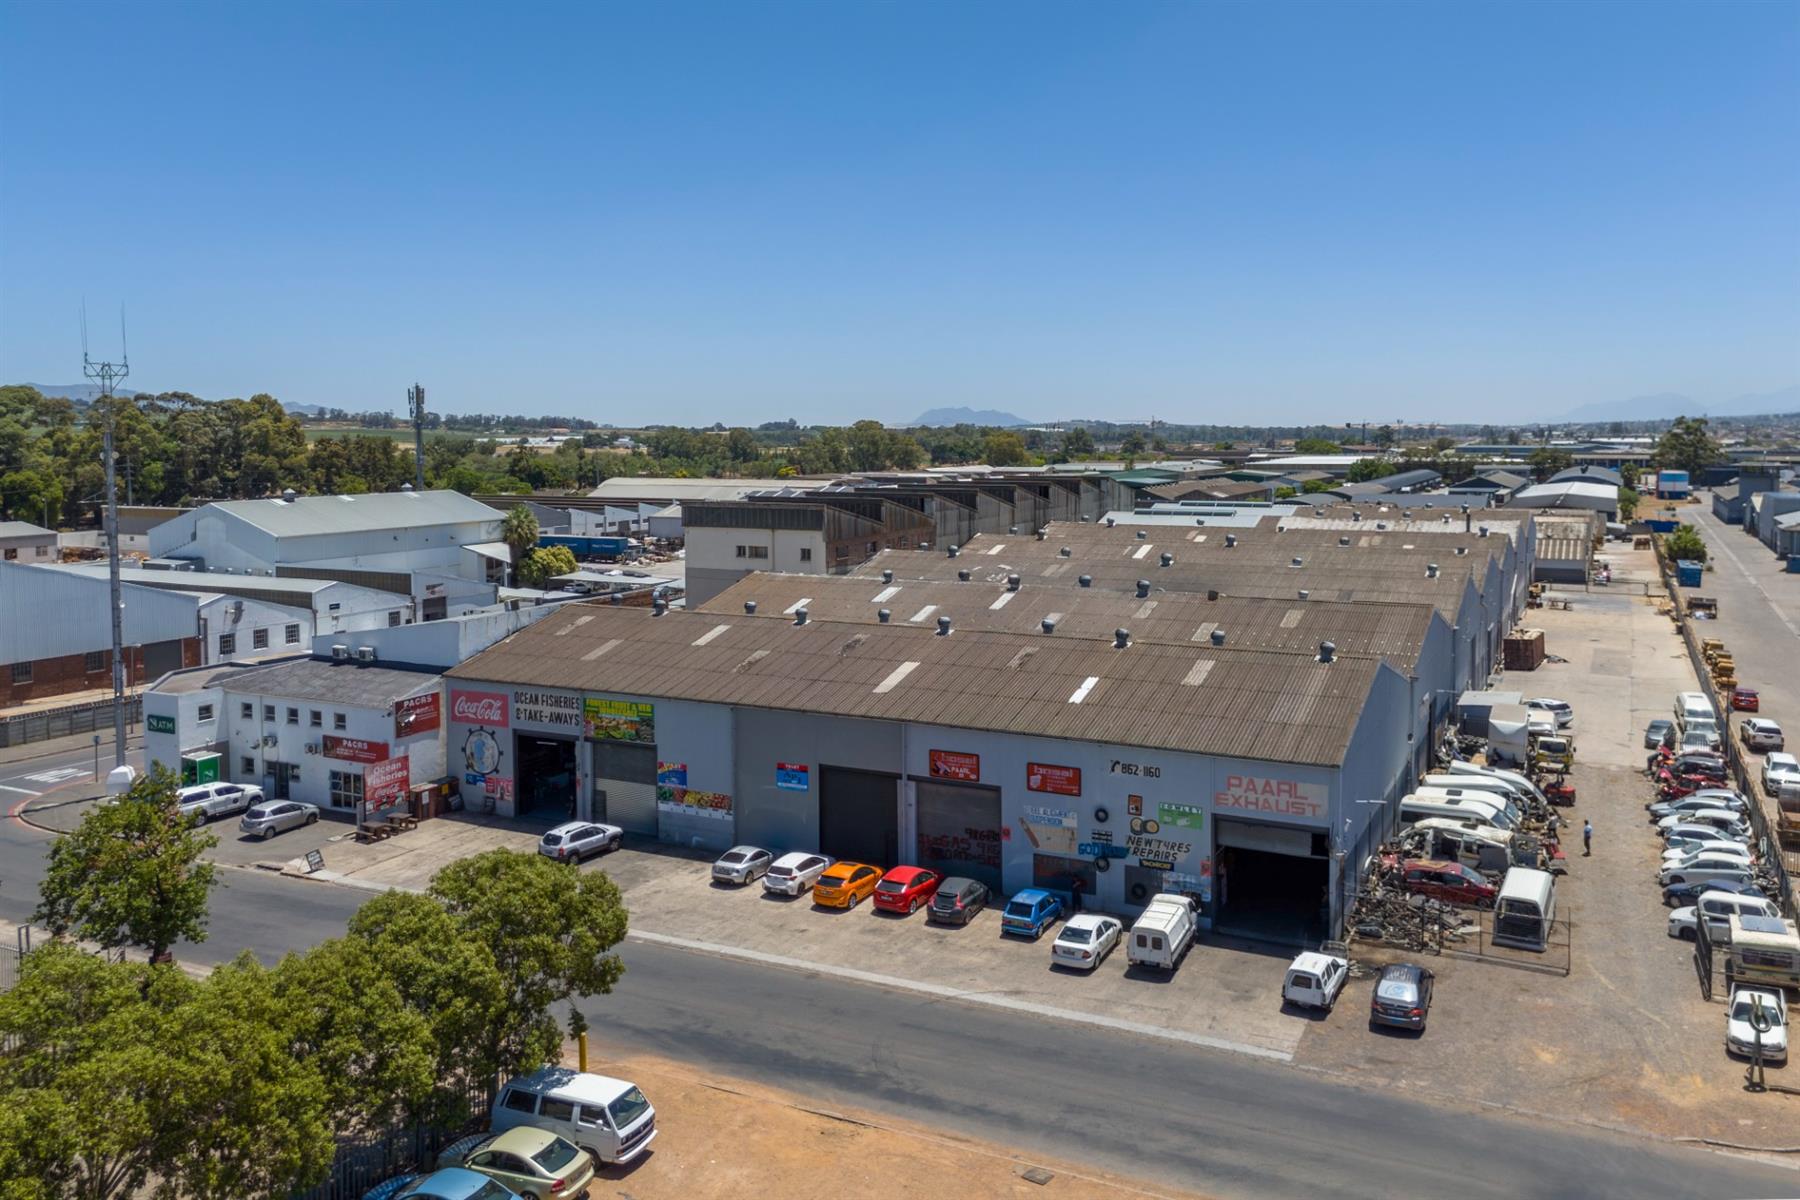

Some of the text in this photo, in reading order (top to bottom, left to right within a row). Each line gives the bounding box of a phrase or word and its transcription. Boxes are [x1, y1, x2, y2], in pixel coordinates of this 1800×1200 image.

[514, 691, 580, 710] OCEAN FISHERIES
[159, 720, 174, 731] ATM
[373, 762, 402, 776] Ocean
[1227, 775, 1309, 801] PAARL
[1215, 792, 1321, 817] EXHAUST
[1126, 835, 1156, 849] NEW
[1131, 847, 1178, 862] REPAIRS
